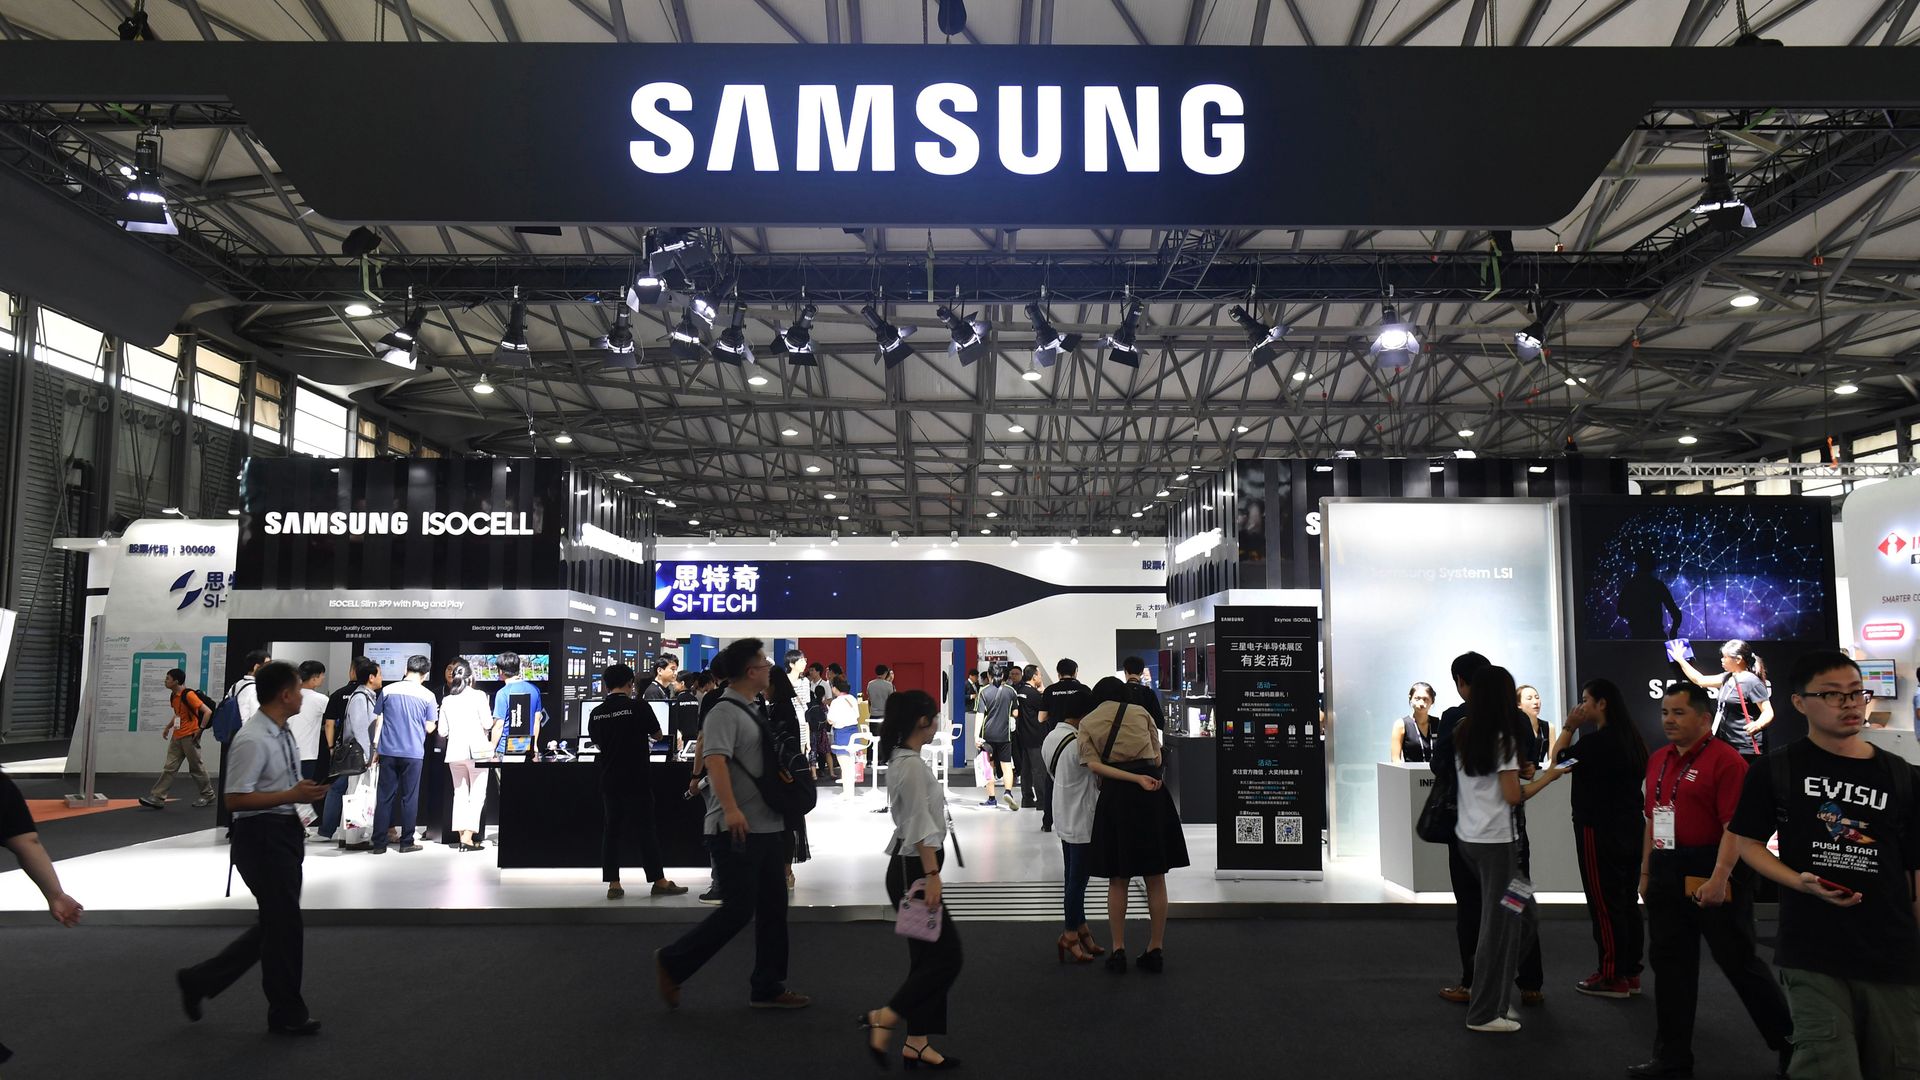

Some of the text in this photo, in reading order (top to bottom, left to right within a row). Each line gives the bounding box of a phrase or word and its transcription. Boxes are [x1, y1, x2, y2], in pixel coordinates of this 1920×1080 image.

[629, 82, 1245, 175] SAMSUNG
[264, 511, 534, 535] SAMSUNG ISOCELL
[673, 564, 760, 592] 思特奇
[1439, 567, 1491, 581] System
[1493, 567, 1513, 579] LSI
[203, 593, 228, 608] SI-
[329, 600, 464, 610] ISOCELL Slim 3P9 with Plug and Play
[672, 593, 757, 613] SI-TECH
[1882, 594, 1911, 604] SMARTER
[1230, 642, 1303, 652] 三星电子半导体展区
[1240, 654, 1293, 668] 有奖活动
[1804, 776, 1888, 810] EVISU
[1812, 841, 1878, 856] PUSH START
